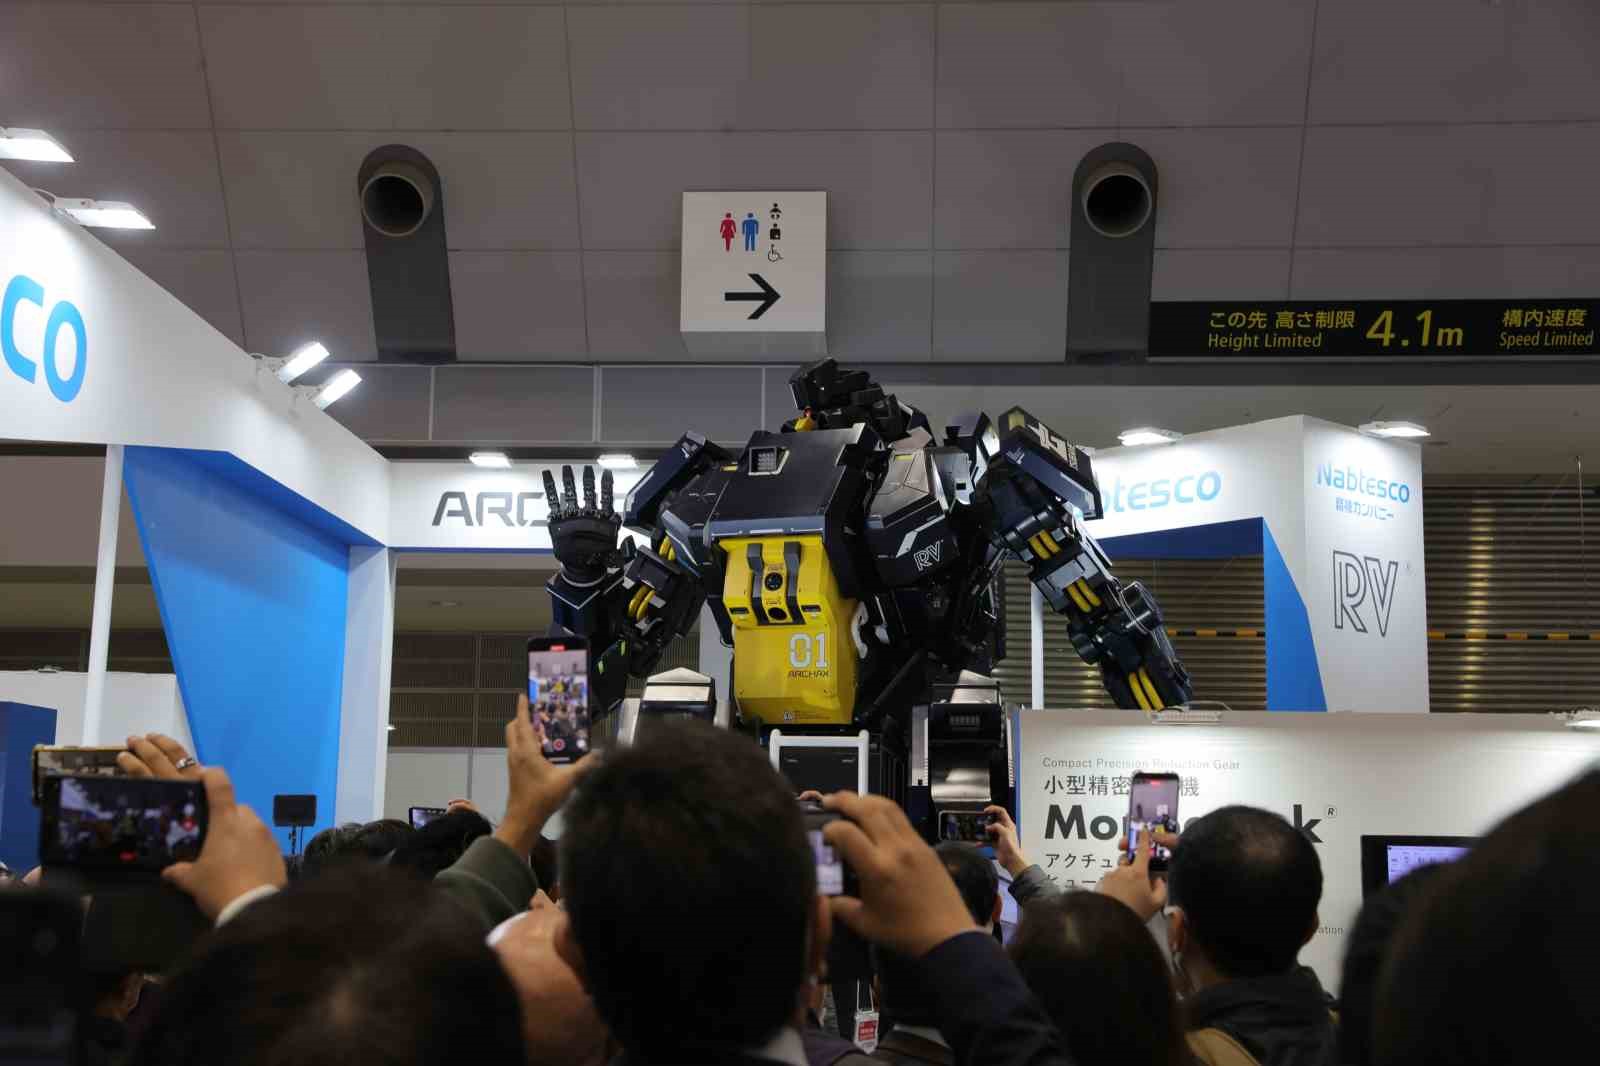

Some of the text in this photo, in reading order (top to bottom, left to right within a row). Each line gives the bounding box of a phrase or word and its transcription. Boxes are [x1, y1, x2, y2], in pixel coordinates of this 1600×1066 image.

[1209, 311, 1355, 329] この先 高さ制限
[1366, 310, 1464, 346] 4.1m
[1502, 309, 1587, 328] 構内速度
[1208, 333, 1322, 351] Height Limited
[1499, 330, 1594, 349] Speed Limited
[1316, 464, 1410, 503] Nabtesco
[432, 491, 550, 527] ARC
[914, 541, 940, 571] RV
[1333, 550, 1398, 637] RV
[790, 632, 828, 669] 01
[1042, 757, 1092, 770] Compact
[1096, 758, 1149, 769] Precision
[1213, 759, 1240, 770] Gear
[1044, 775, 1200, 797] 小型精密機
[1047, 853, 1113, 869] アクチュ
